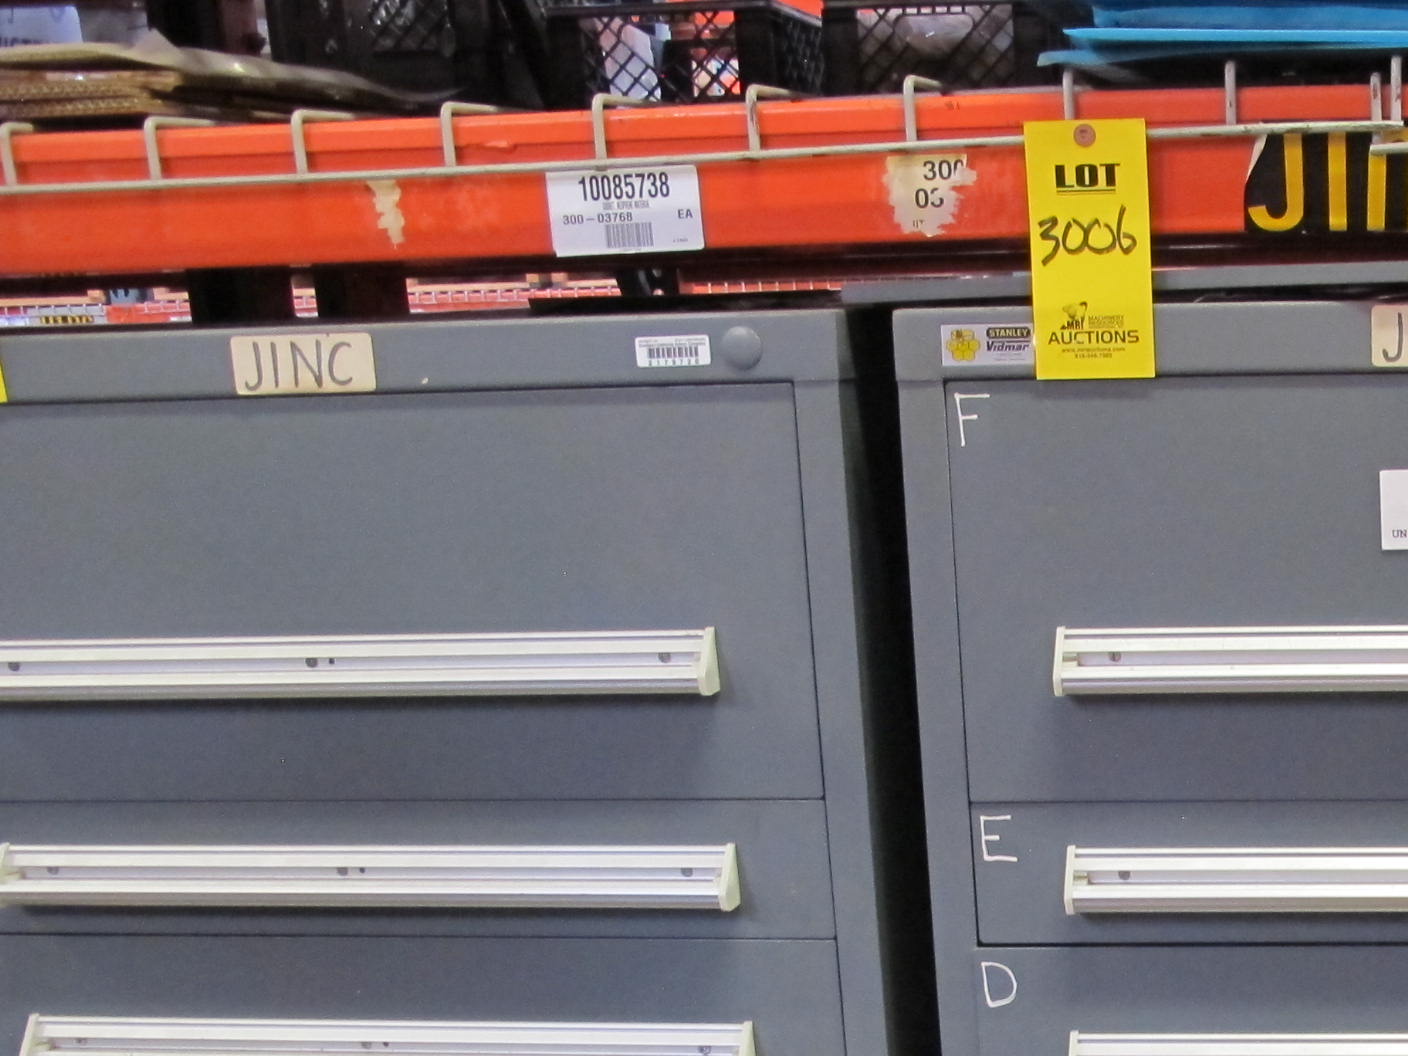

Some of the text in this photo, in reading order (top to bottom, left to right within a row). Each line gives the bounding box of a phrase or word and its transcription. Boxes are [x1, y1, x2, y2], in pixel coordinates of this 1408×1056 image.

[578, 171, 671, 202] 10085738
[1054, 162, 1121, 189] LOT
[677, 208, 694, 220] EA
[1037, 204, 1138, 267] 3006
[985, 341, 1029, 353] Vidmar
[988, 328, 1029, 338] STANLEY
[1047, 329, 1140, 346] AUCTIONS
[244, 339, 353, 392] JINC
[953, 392, 991, 448] F
[979, 814, 1019, 863] E
[980, 961, 1018, 1009] D
